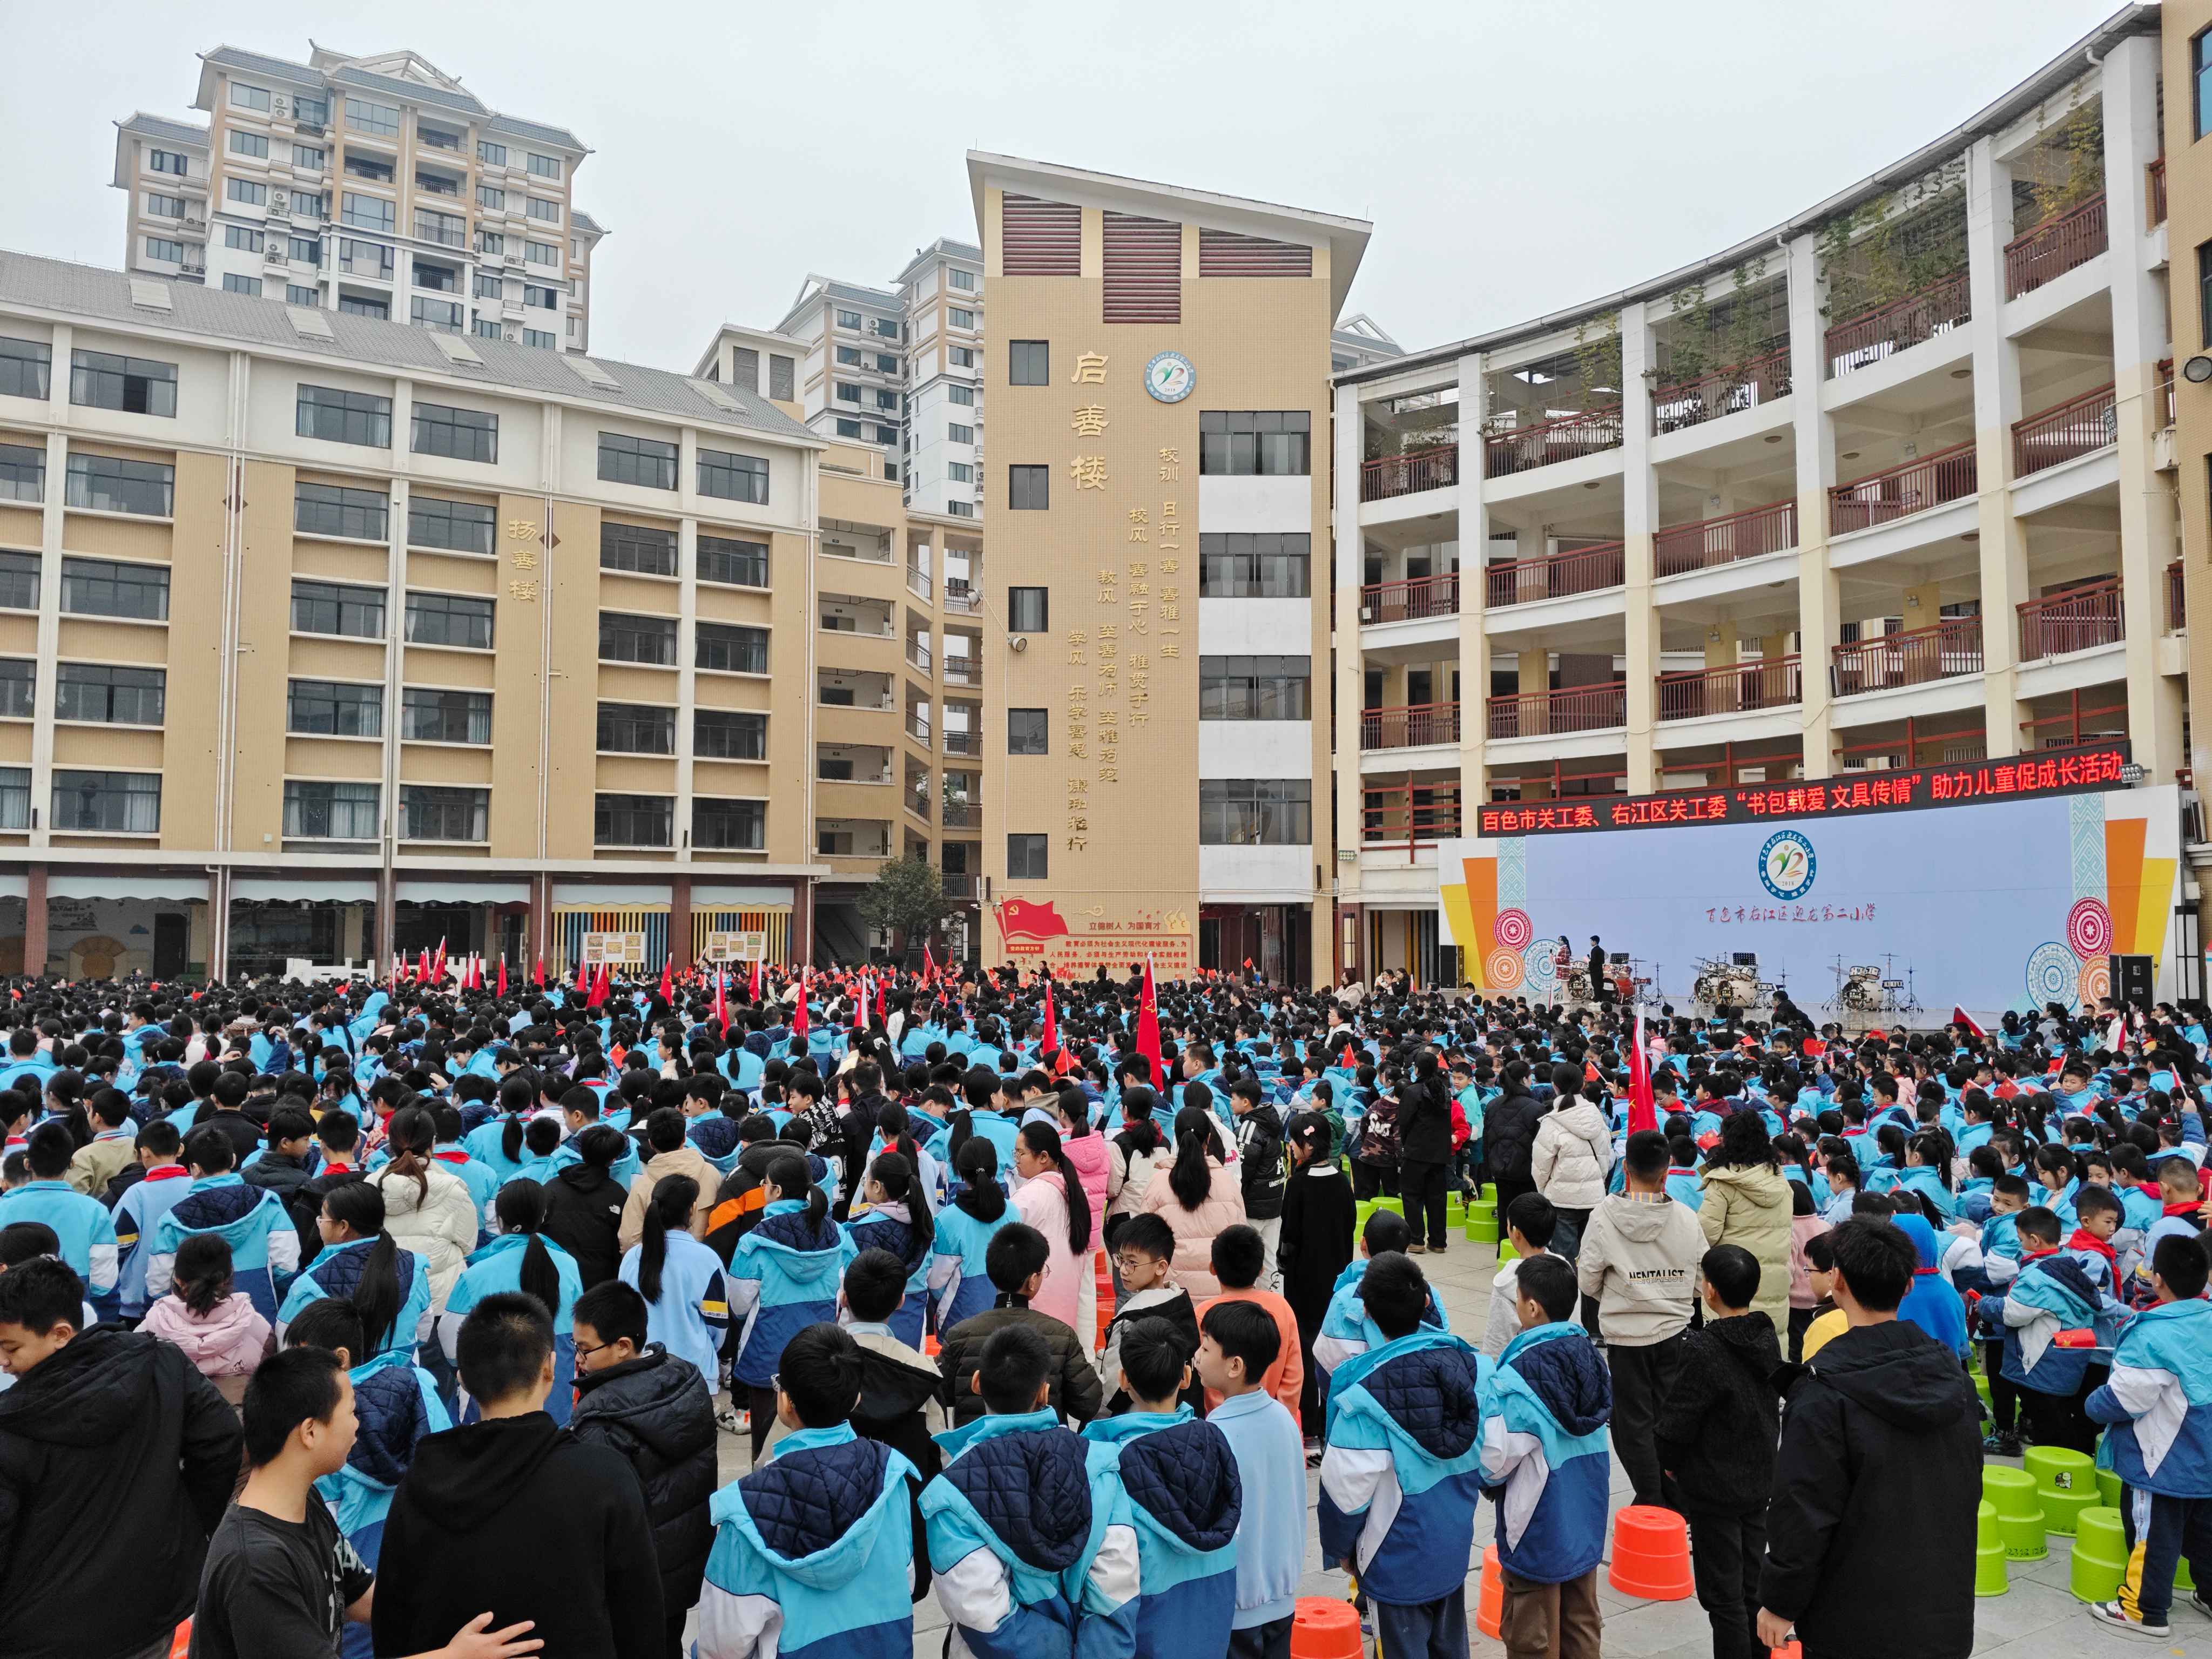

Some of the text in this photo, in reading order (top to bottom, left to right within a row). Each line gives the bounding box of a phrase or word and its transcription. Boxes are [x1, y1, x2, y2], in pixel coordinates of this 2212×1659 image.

[1069, 350, 1110, 491] 启善楼
[508, 519, 539, 602] 扬善楼
[1129, 507, 1150, 728] 校风 善融于心 雅贯于行
[1159, 447, 1181, 659] 校训 日行一善 善雅一生
[1067, 630, 1089, 851] 学风 乐学善思 谦和雅行
[1097, 569, 1119, 783] 教风 至善为师 至雅为范
[1089, 921, 1161, 930] 立德树人 为国育才
[1705, 902, 1876, 923] 百色市右江区迎龙第二小学
[1628, 1269, 1685, 1285] MENTALIST
